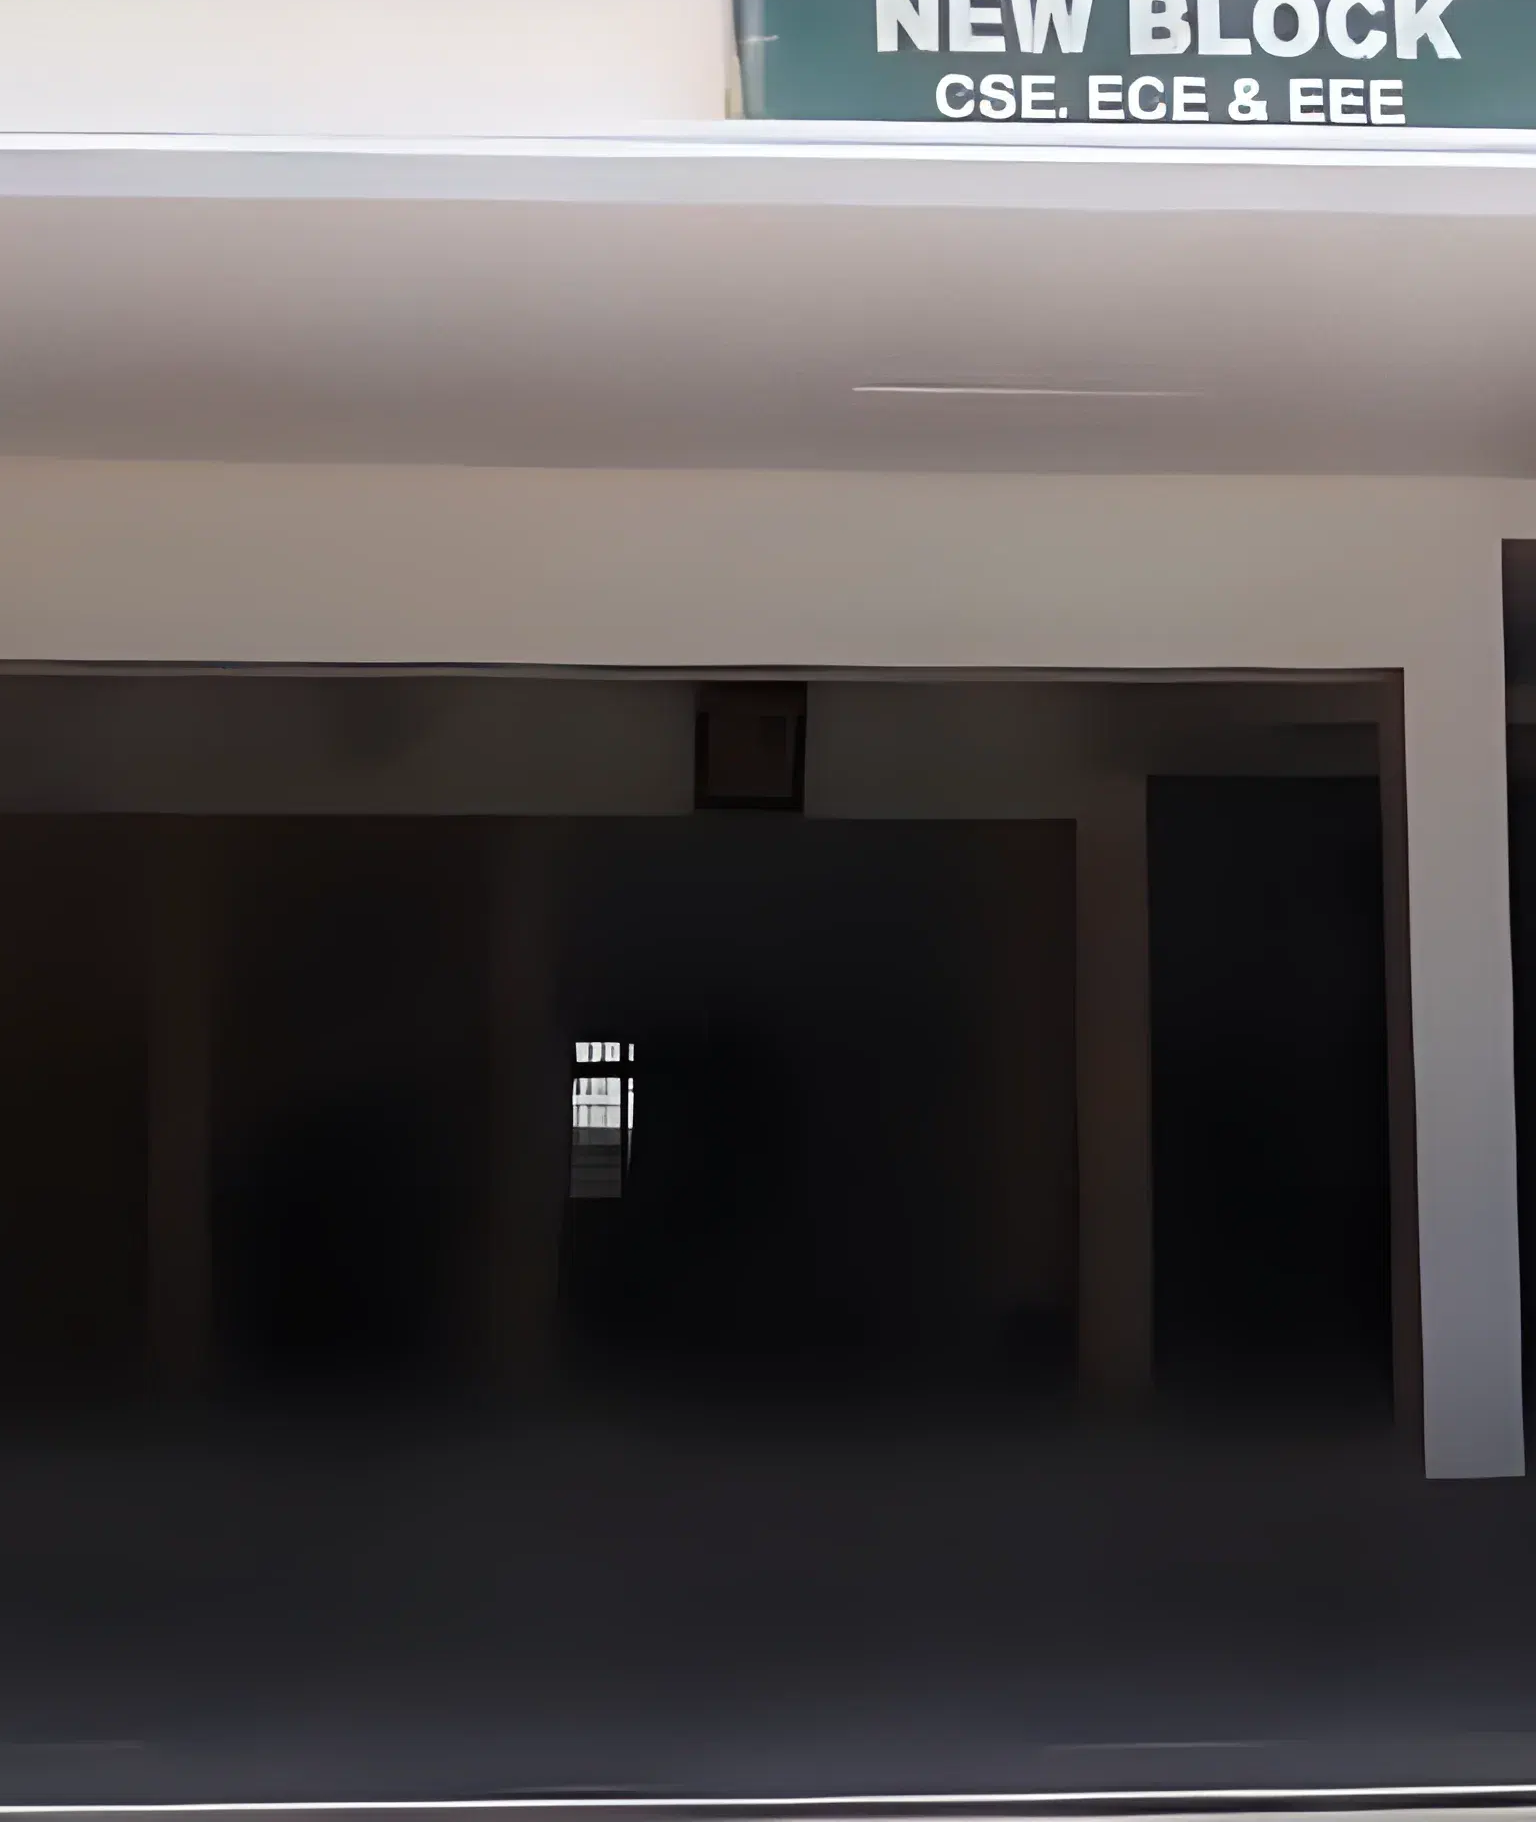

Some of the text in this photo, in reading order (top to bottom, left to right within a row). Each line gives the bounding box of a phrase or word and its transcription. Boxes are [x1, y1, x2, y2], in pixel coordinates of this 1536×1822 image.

[1087, 73, 1211, 122] ECE
[1226, 76, 1270, 123] &
[1288, 77, 1407, 126] EEE
